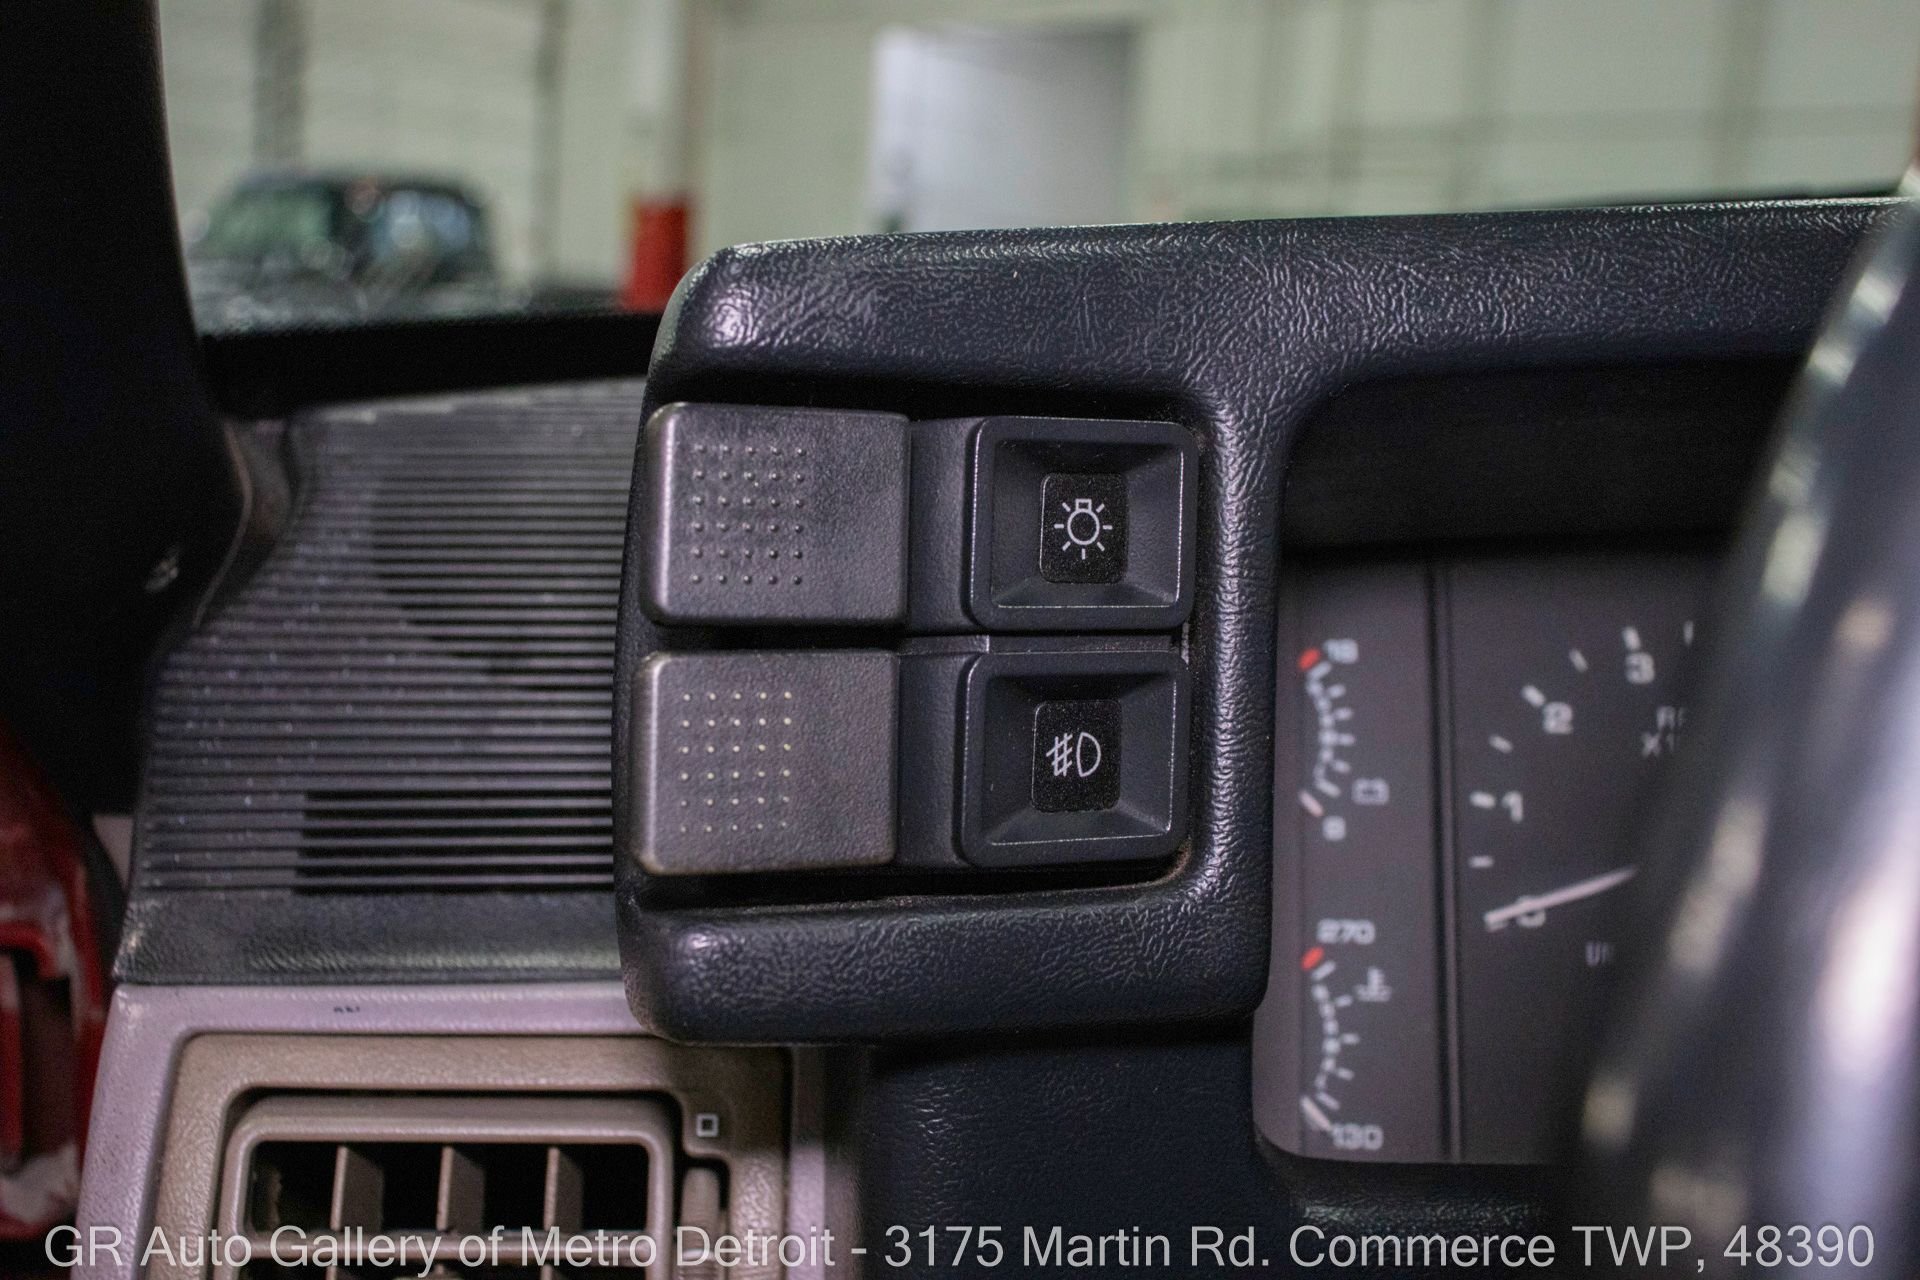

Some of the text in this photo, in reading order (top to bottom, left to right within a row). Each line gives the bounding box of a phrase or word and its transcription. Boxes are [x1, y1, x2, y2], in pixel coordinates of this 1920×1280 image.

[1625, 652, 1656, 684] 3
[1543, 702, 1573, 735] 2
[1503, 791, 1524, 823] 1
[1317, 918, 1376, 945] 270
